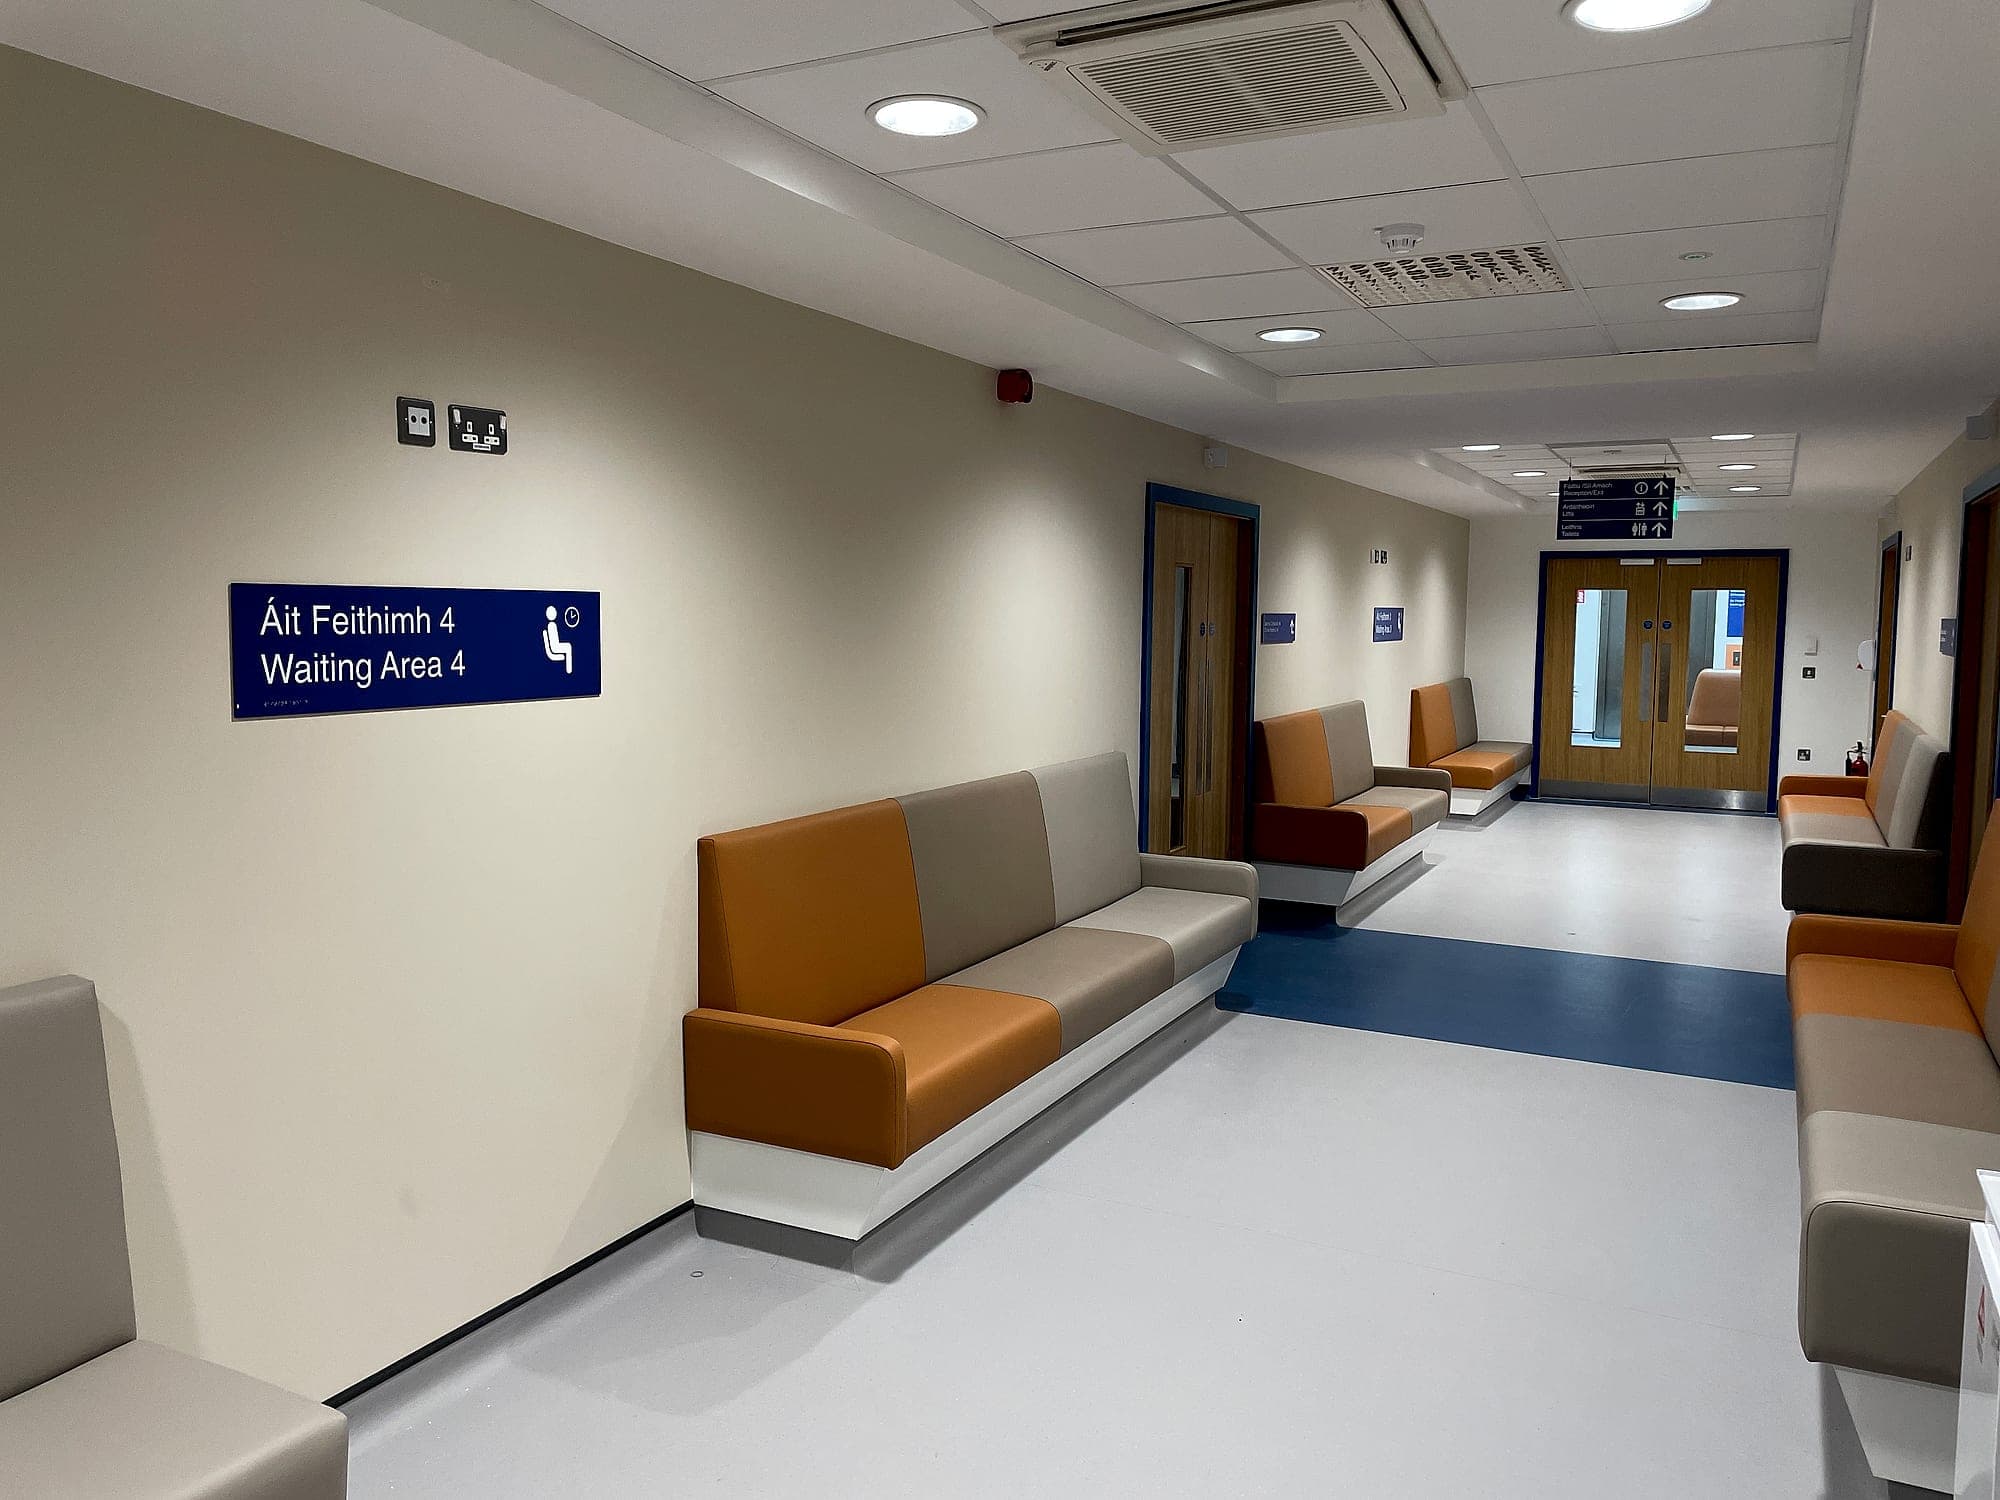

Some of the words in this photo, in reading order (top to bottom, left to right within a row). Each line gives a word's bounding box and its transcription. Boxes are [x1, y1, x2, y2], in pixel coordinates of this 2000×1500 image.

[259, 597, 302, 636] Áit
[312, 604, 431, 636] Feithimh
[439, 606, 456, 634] 4
[260, 652, 372, 689] Waiting
[380, 650, 443, 680] Area
[450, 649, 466, 677] 4
